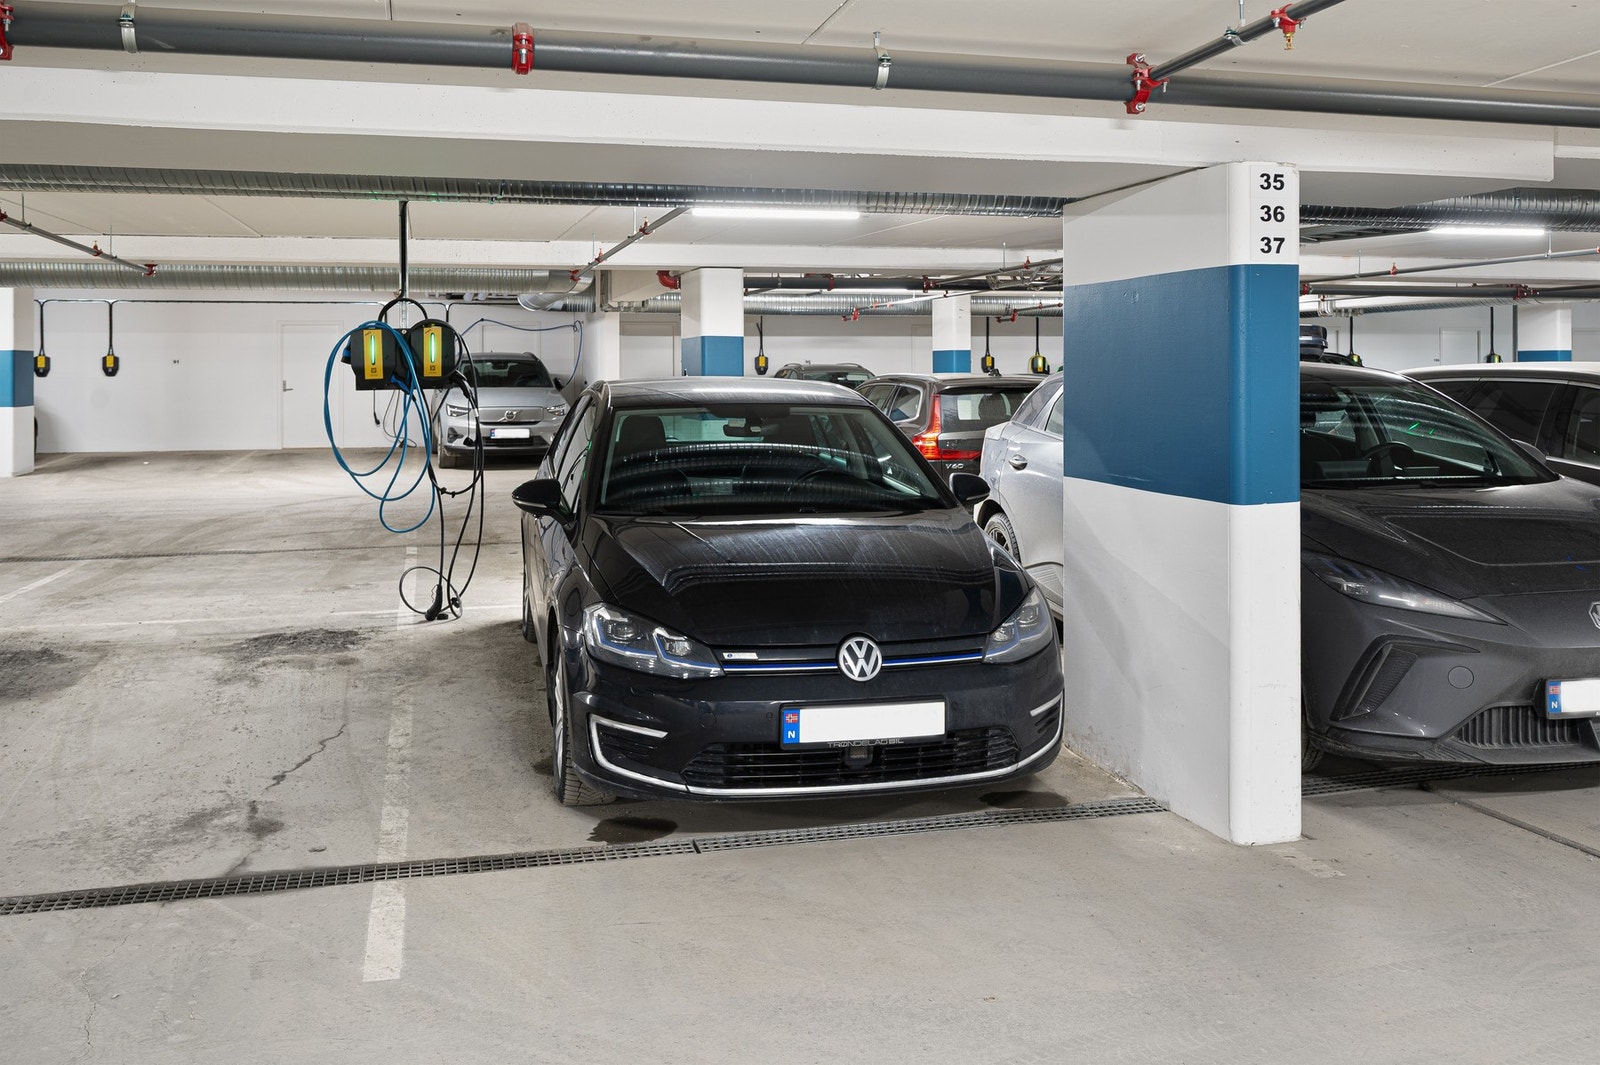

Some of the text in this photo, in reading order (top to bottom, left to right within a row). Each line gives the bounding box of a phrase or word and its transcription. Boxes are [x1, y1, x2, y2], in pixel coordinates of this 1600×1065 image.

[1259, 173, 1285, 191] 35
[1260, 205, 1286, 223] 36
[1260, 236, 1286, 254] 37
[839, 636, 883, 682] VW
[1551, 701, 1558, 709] N
[787, 730, 796, 739] N
